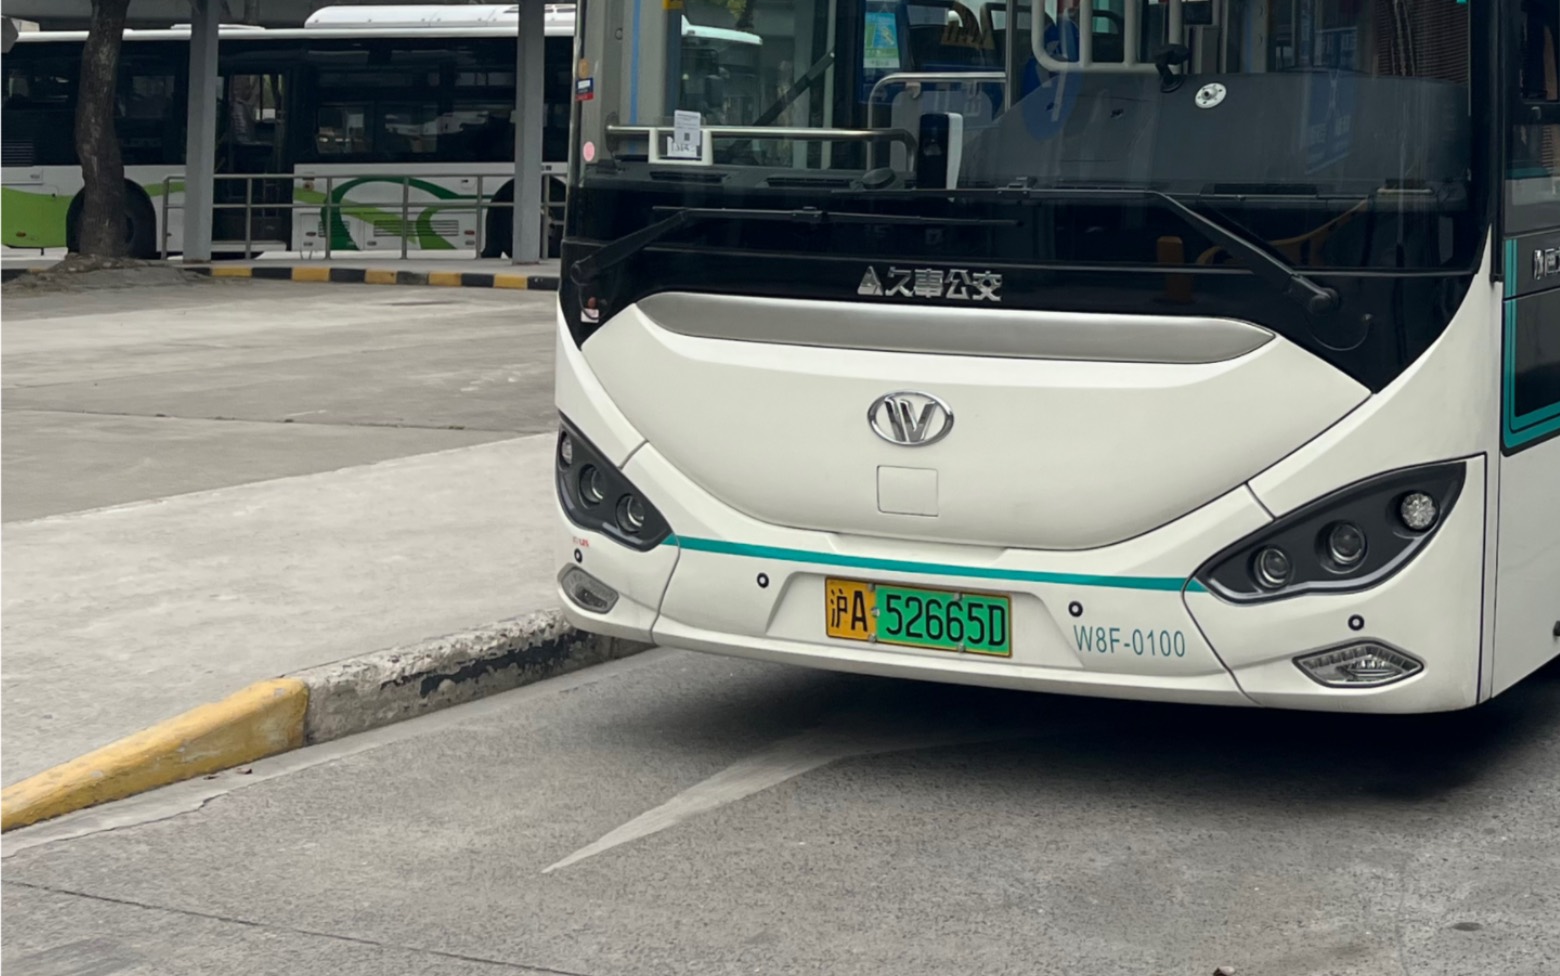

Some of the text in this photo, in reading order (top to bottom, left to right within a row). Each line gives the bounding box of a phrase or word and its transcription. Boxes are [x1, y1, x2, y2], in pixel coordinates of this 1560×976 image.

[884, 266, 1003, 302] 久事公交
[884, 593, 1007, 647] 52665D
[1073, 624, 1186, 658] W8F-0100
